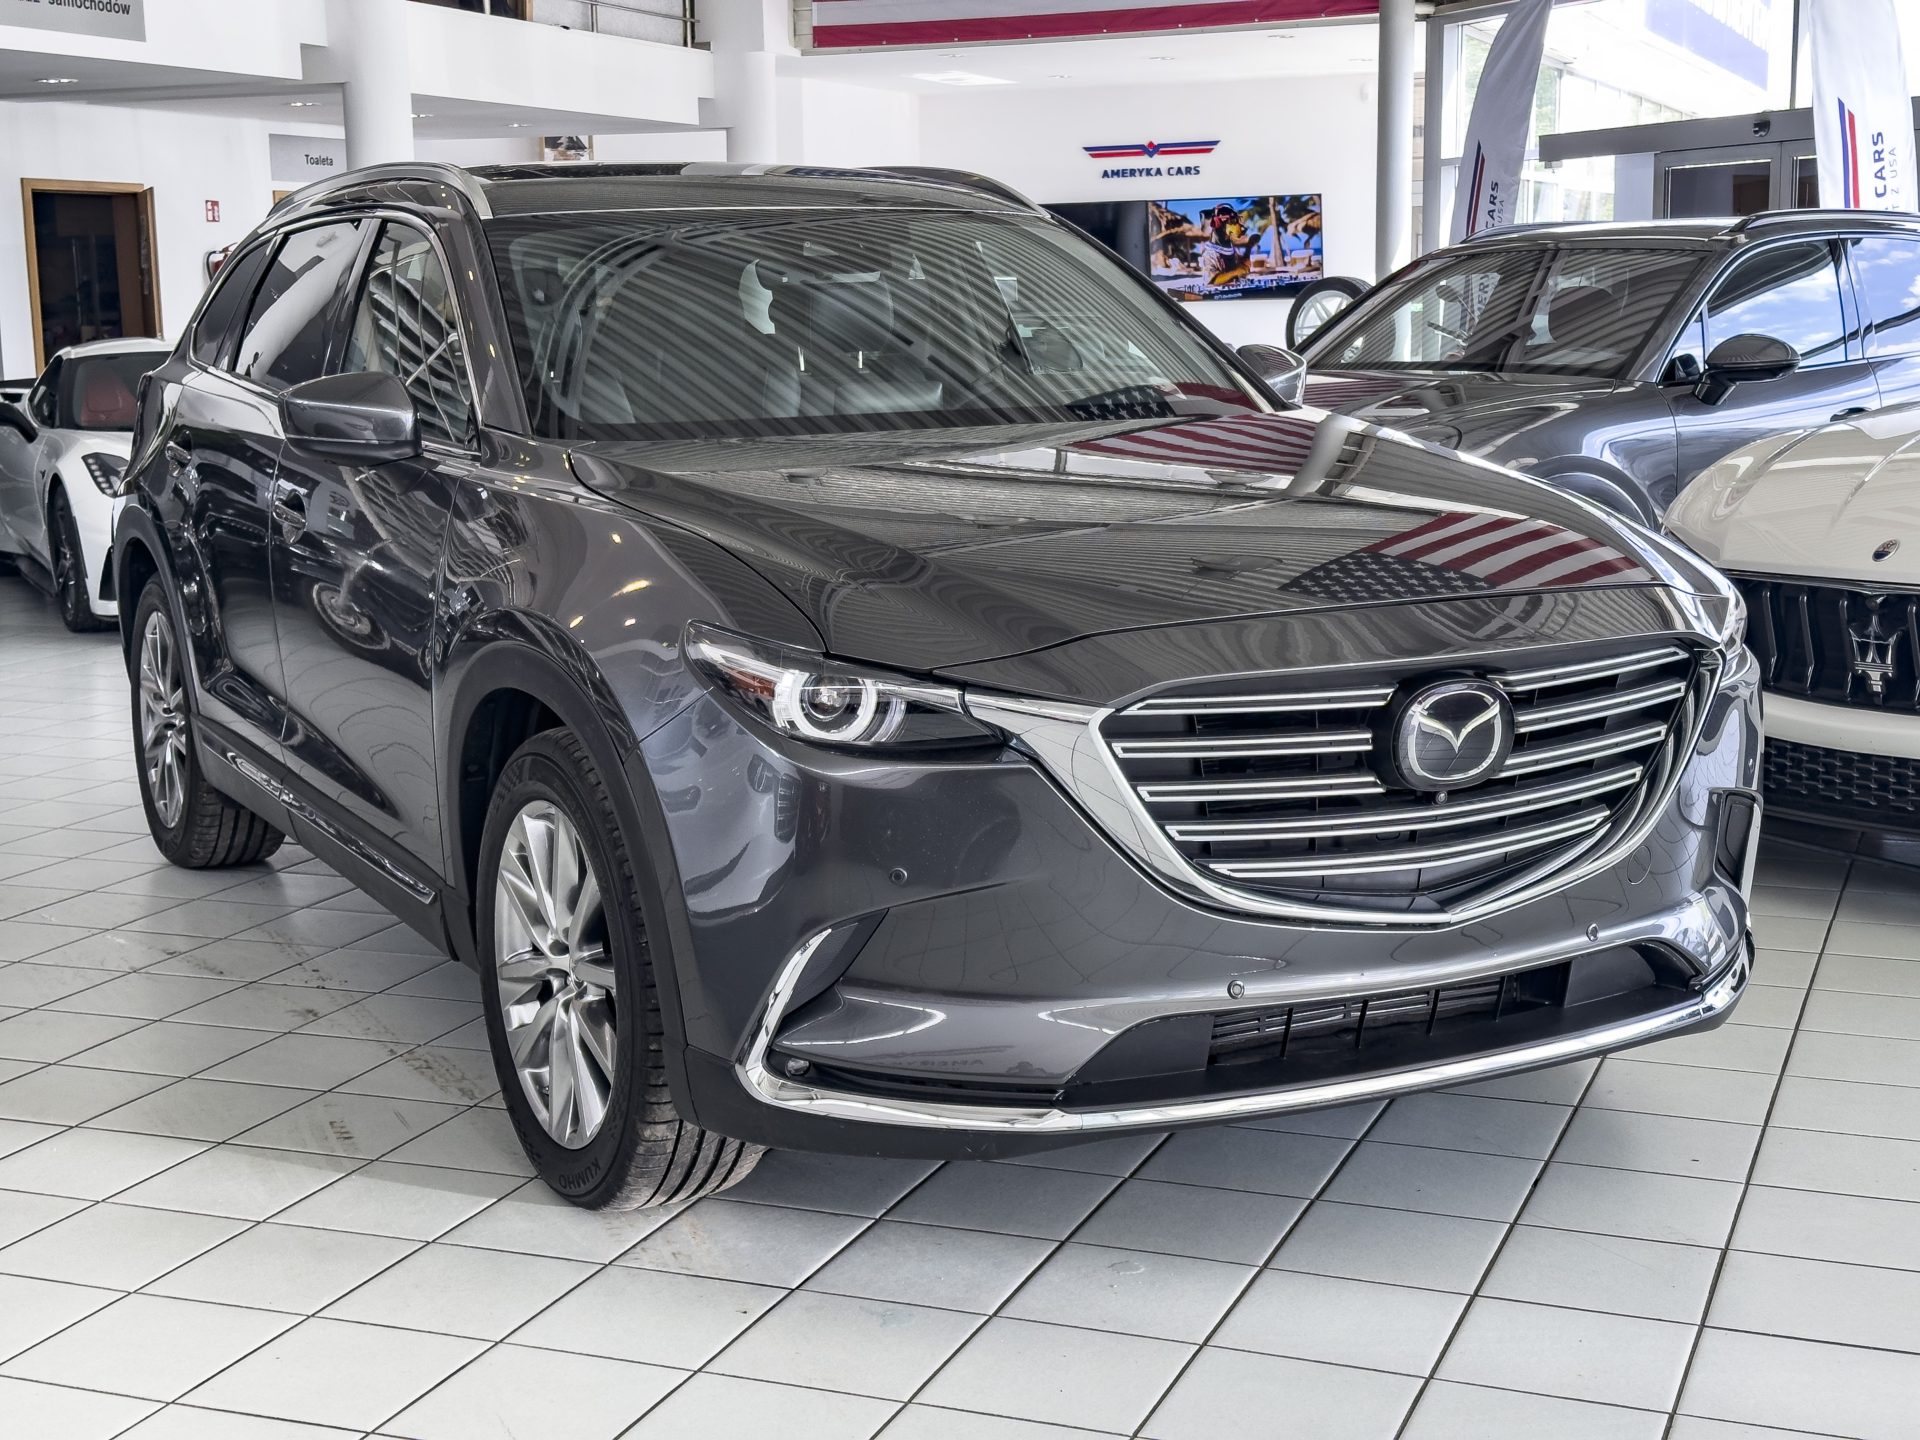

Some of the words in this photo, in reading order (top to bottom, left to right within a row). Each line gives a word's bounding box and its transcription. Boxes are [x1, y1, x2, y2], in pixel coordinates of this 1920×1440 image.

[304, 154, 334, 166] Toaleta
[1101, 167, 1163, 179] AMERYKA
[1167, 165, 1200, 177] CARS
[1871, 131, 1887, 198] CARS
[1888, 147, 1898, 179] USA
[1497, 200, 1505, 224] USA
[558, 1156, 601, 1190] KUMHO
